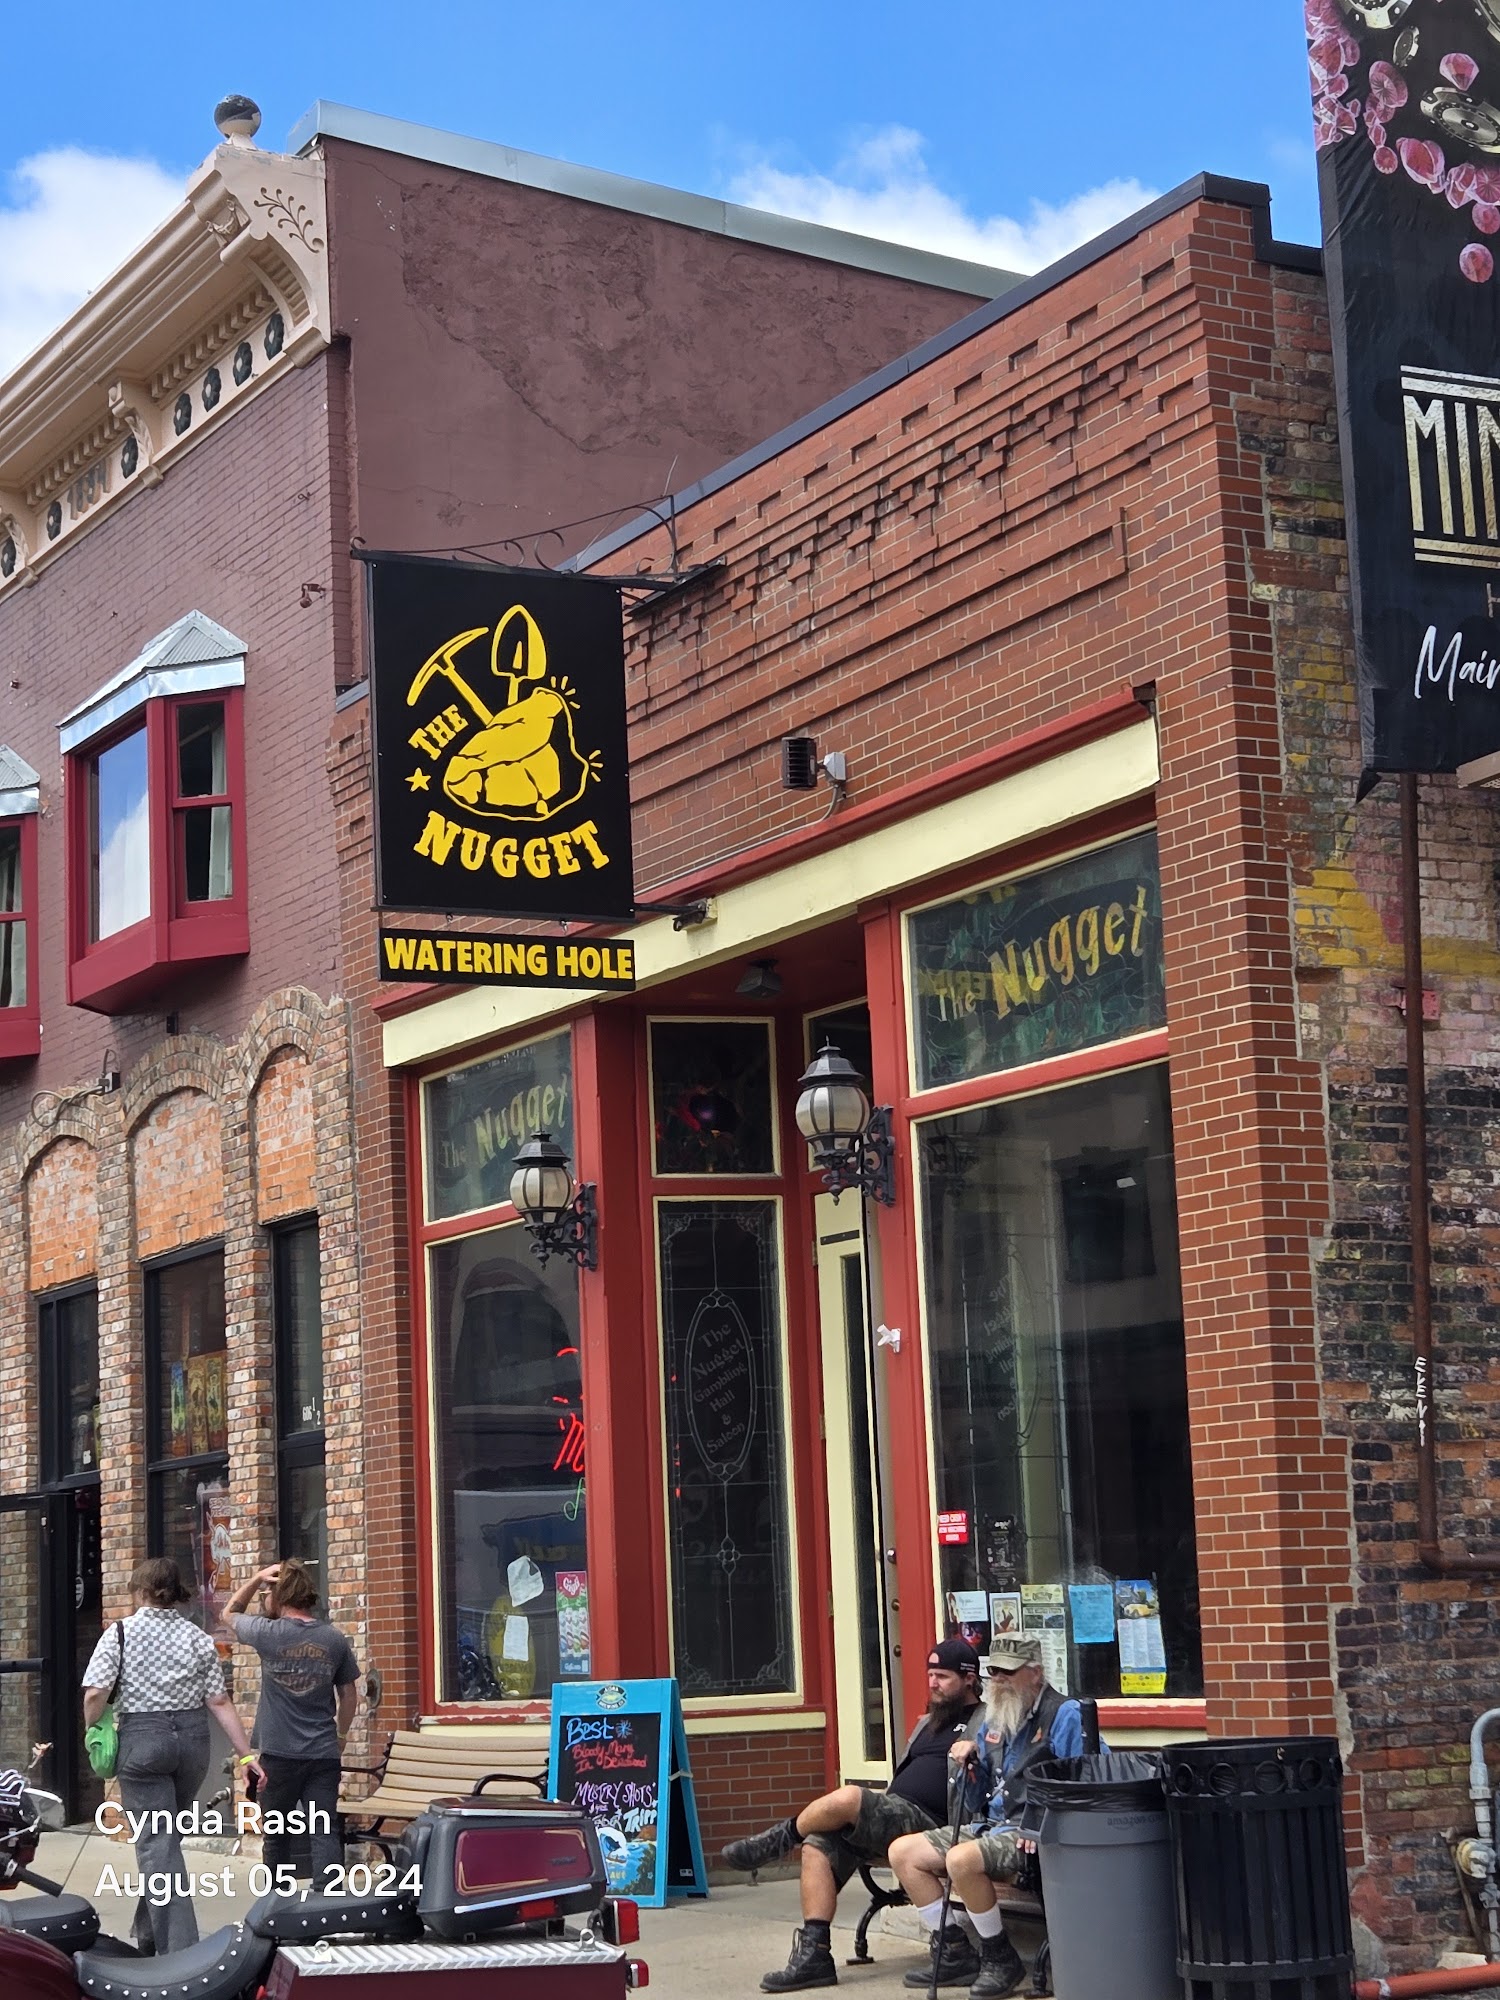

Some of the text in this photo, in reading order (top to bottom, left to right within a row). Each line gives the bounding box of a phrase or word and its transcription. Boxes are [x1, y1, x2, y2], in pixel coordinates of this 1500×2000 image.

[408, 704, 469, 761] THE
[413, 810, 610, 879] NUGGET
[383, 937, 634, 980] WATERING HOLE
[988, 884, 1147, 1021] Nugget
[474, 1074, 568, 1172] Nugget
[699, 1324, 732, 1348] The
[691, 1338, 746, 1381] Nugget
[693, 1362, 748, 1403] Gambling
[709, 1389, 736, 1413] Hall
[706, 1423, 745, 1454] Saloon
[564, 1717, 614, 1750] Best
[572, 1740, 634, 1766] Bloody Mary
